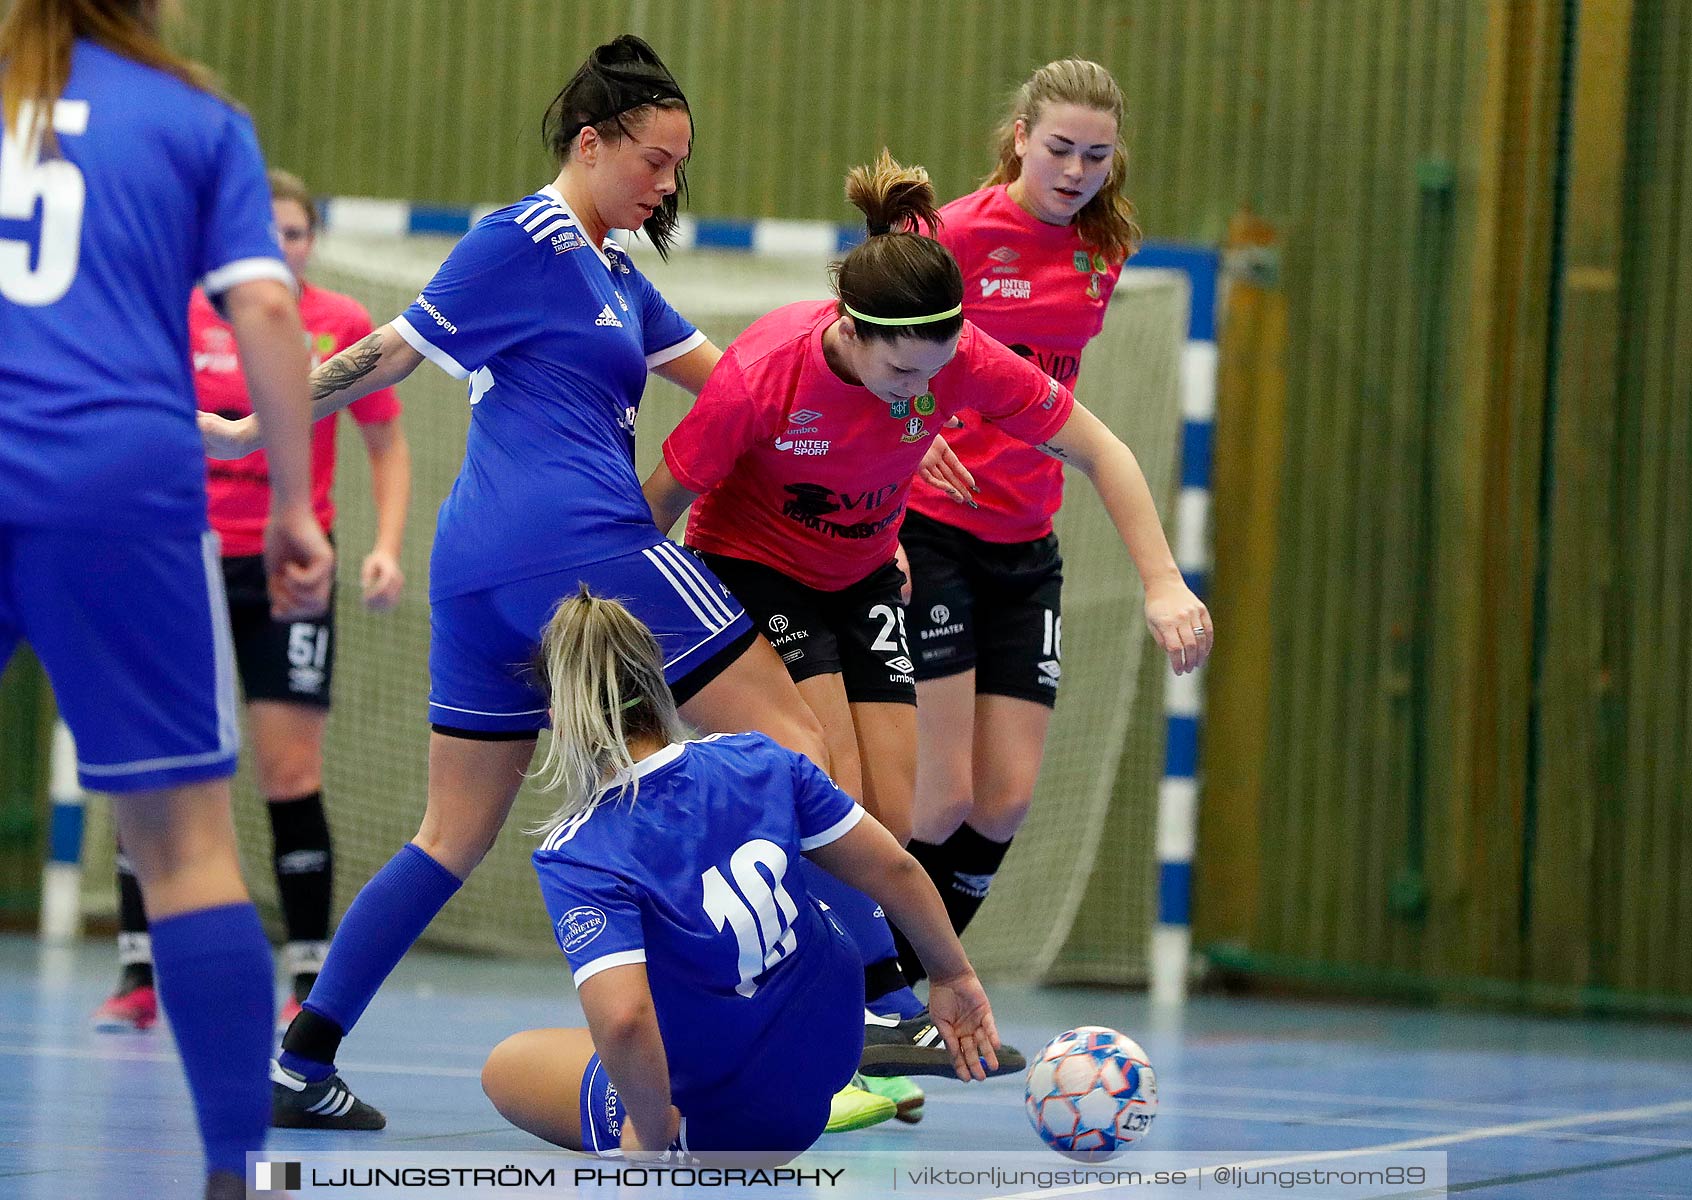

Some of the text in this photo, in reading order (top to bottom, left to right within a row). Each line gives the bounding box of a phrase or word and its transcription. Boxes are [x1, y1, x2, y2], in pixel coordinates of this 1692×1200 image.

[0, 99, 91, 307] 5
[1001, 278, 1030, 289] INTER
[1001, 288, 1030, 299] SPORT
[595, 319, 623, 328] adidas
[787, 426, 818, 435] umbro
[794, 440, 829, 449] INTER
[793, 448, 829, 456] SPORT
[920, 623, 964, 640] BAMATEX
[770, 629, 809, 648] AMATEX
[287, 622, 329, 668] 51
[701, 838, 799, 998] 10
